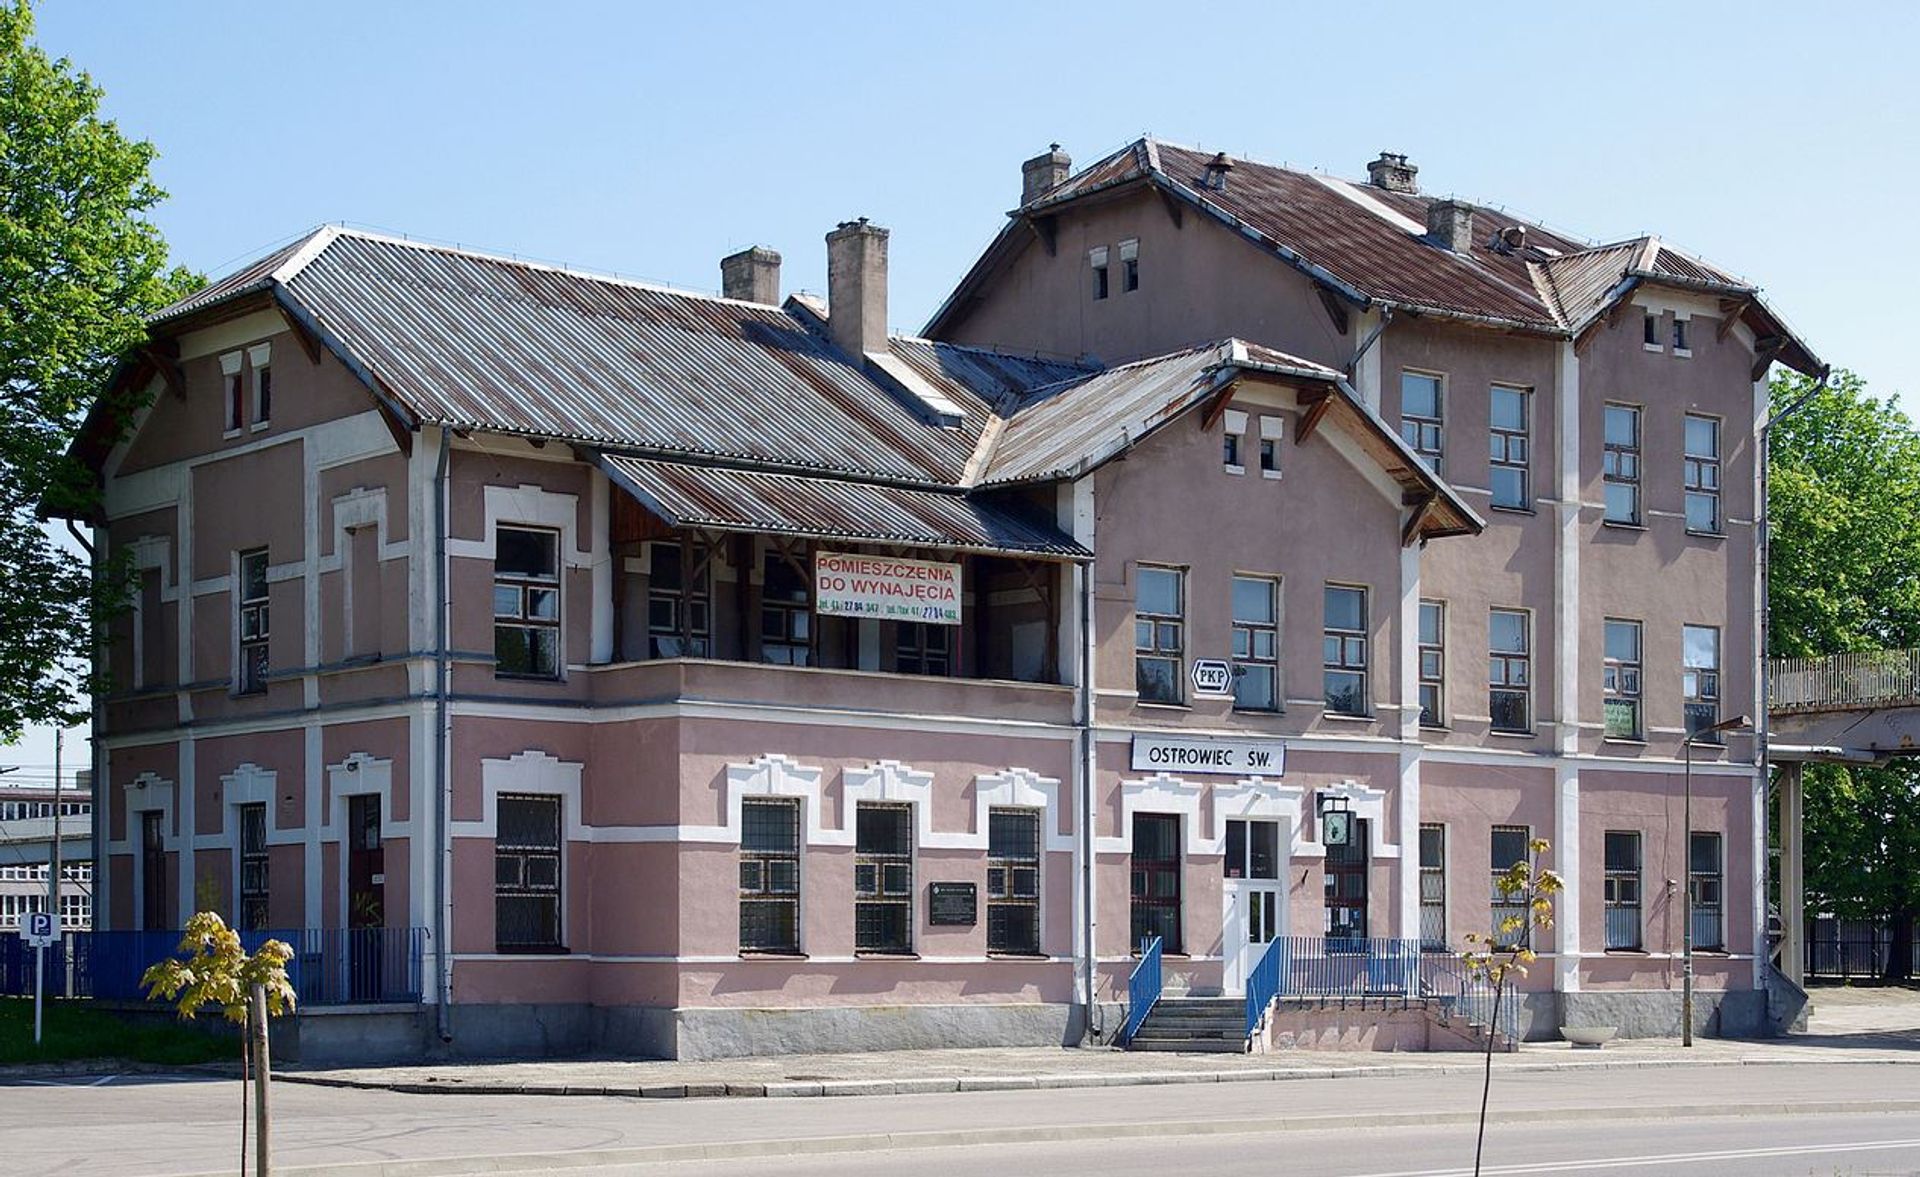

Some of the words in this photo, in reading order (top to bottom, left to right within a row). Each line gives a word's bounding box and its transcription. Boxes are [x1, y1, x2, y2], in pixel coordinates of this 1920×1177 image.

[817, 558, 954, 582] POMIESZCZENIA
[820, 577, 846, 592] DO
[851, 579, 956, 602] WYNAJĘCIA
[1199, 669, 1225, 684] PKP
[1149, 747, 1234, 766] OSTROWIEC
[34, 915, 48, 934] P
